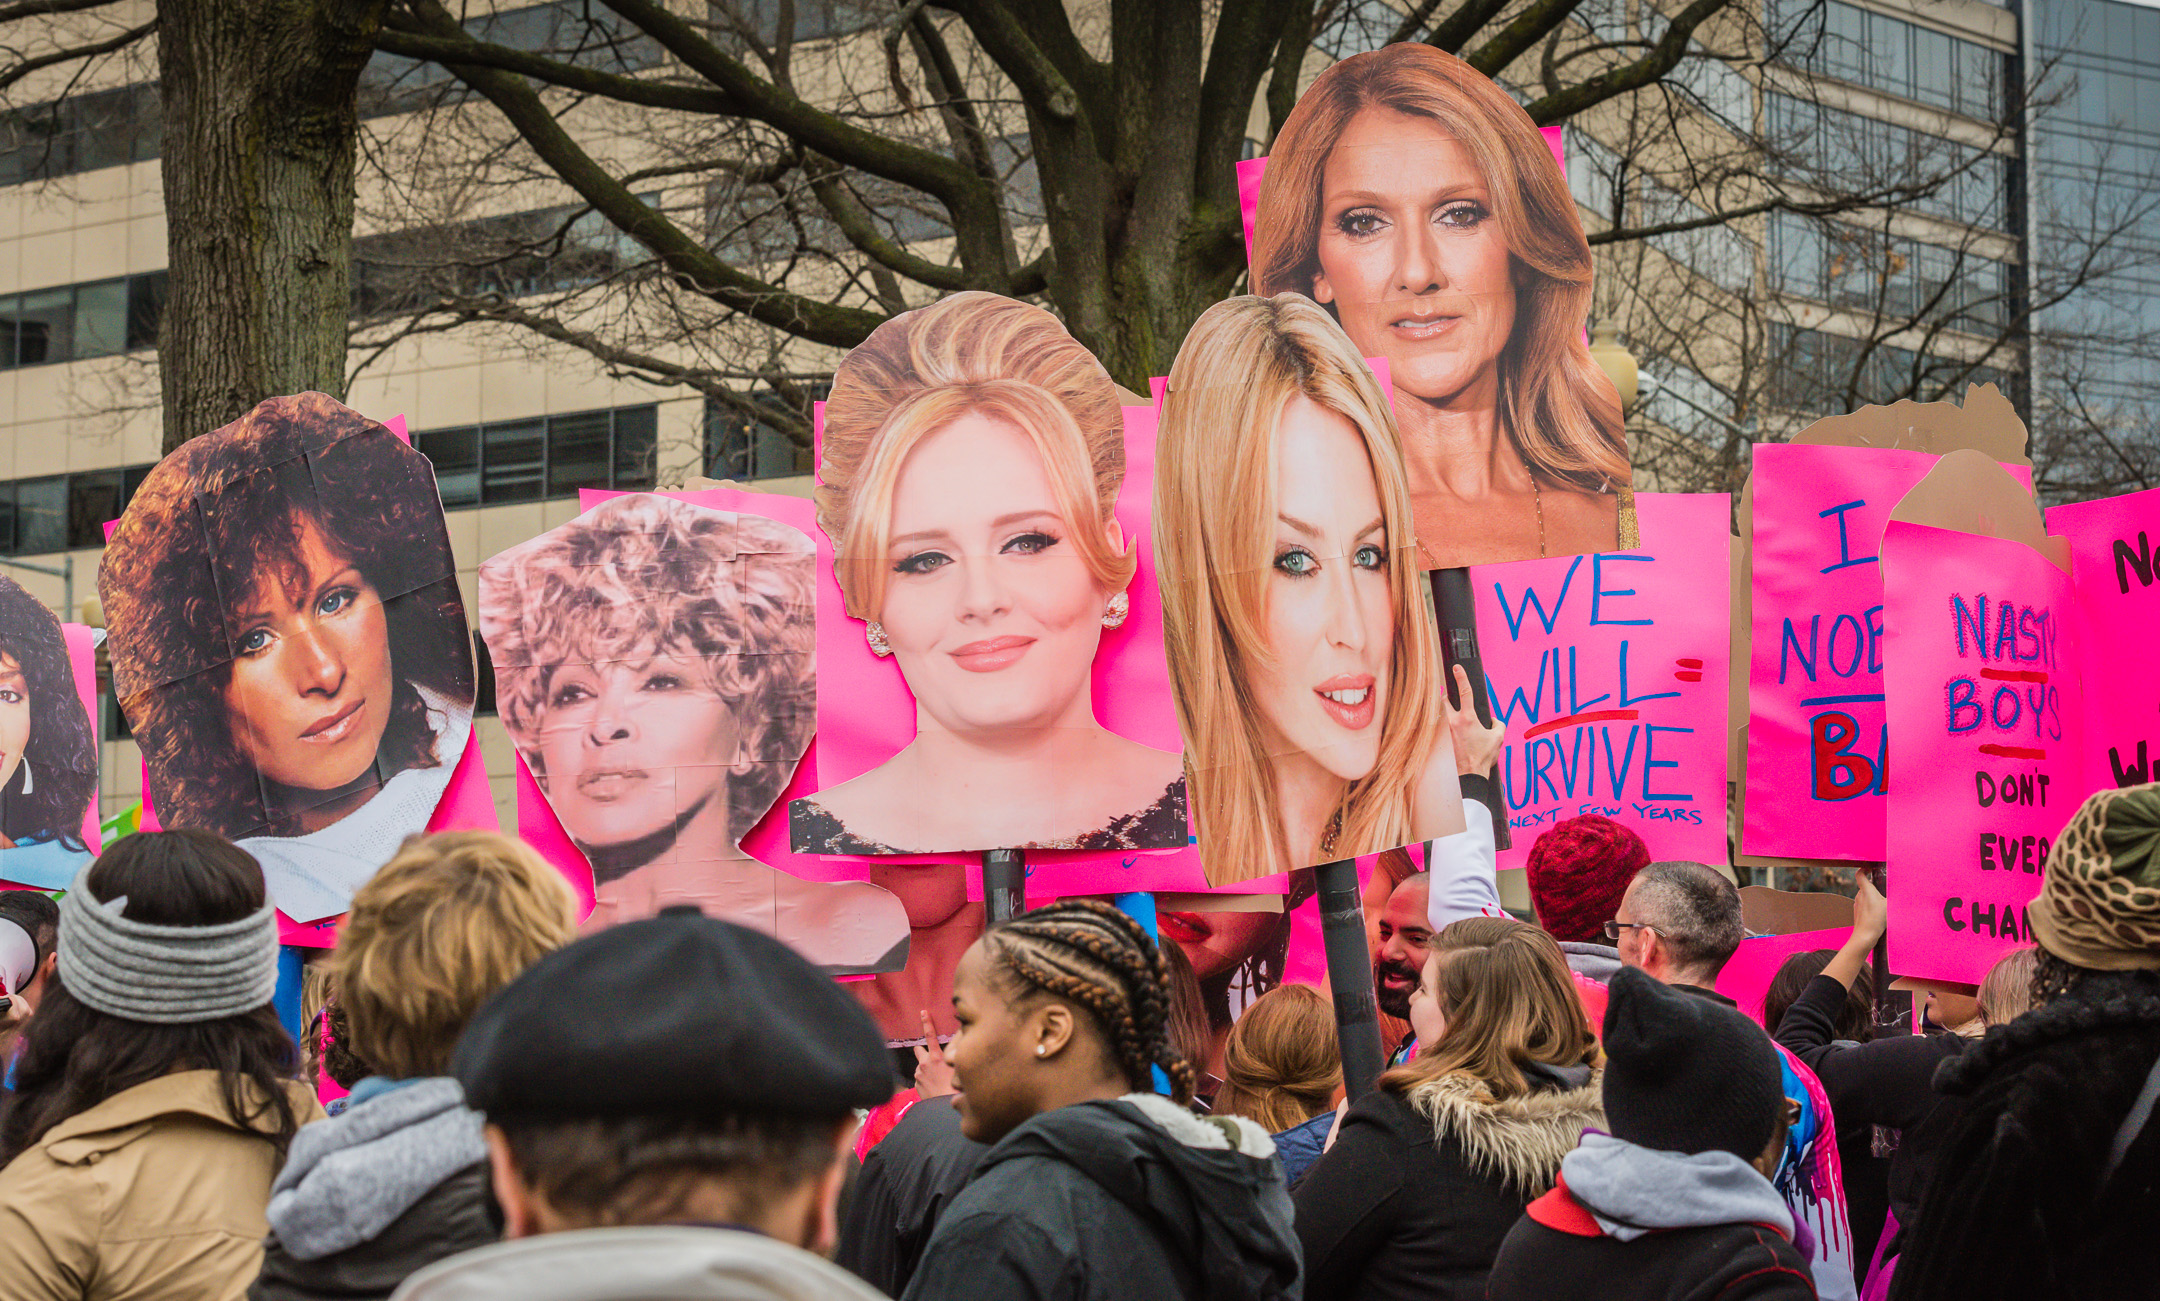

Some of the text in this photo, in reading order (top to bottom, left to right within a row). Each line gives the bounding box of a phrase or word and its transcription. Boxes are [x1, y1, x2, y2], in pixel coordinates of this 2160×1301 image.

[1819, 500, 1879, 574] I
[1494, 553, 1655, 641] WE
[1949, 592, 2056, 670] NASTY
[1485, 640, 1681, 727] WILL
[1945, 674, 2062, 742] BOYS
[1502, 723, 1694, 811] URVIVE
[1975, 767, 2049, 808] DON'T
[1509, 807, 1563, 829] NEXT
[1632, 803, 1703, 826] YEARS
[1979, 832, 2050, 877] EVER
